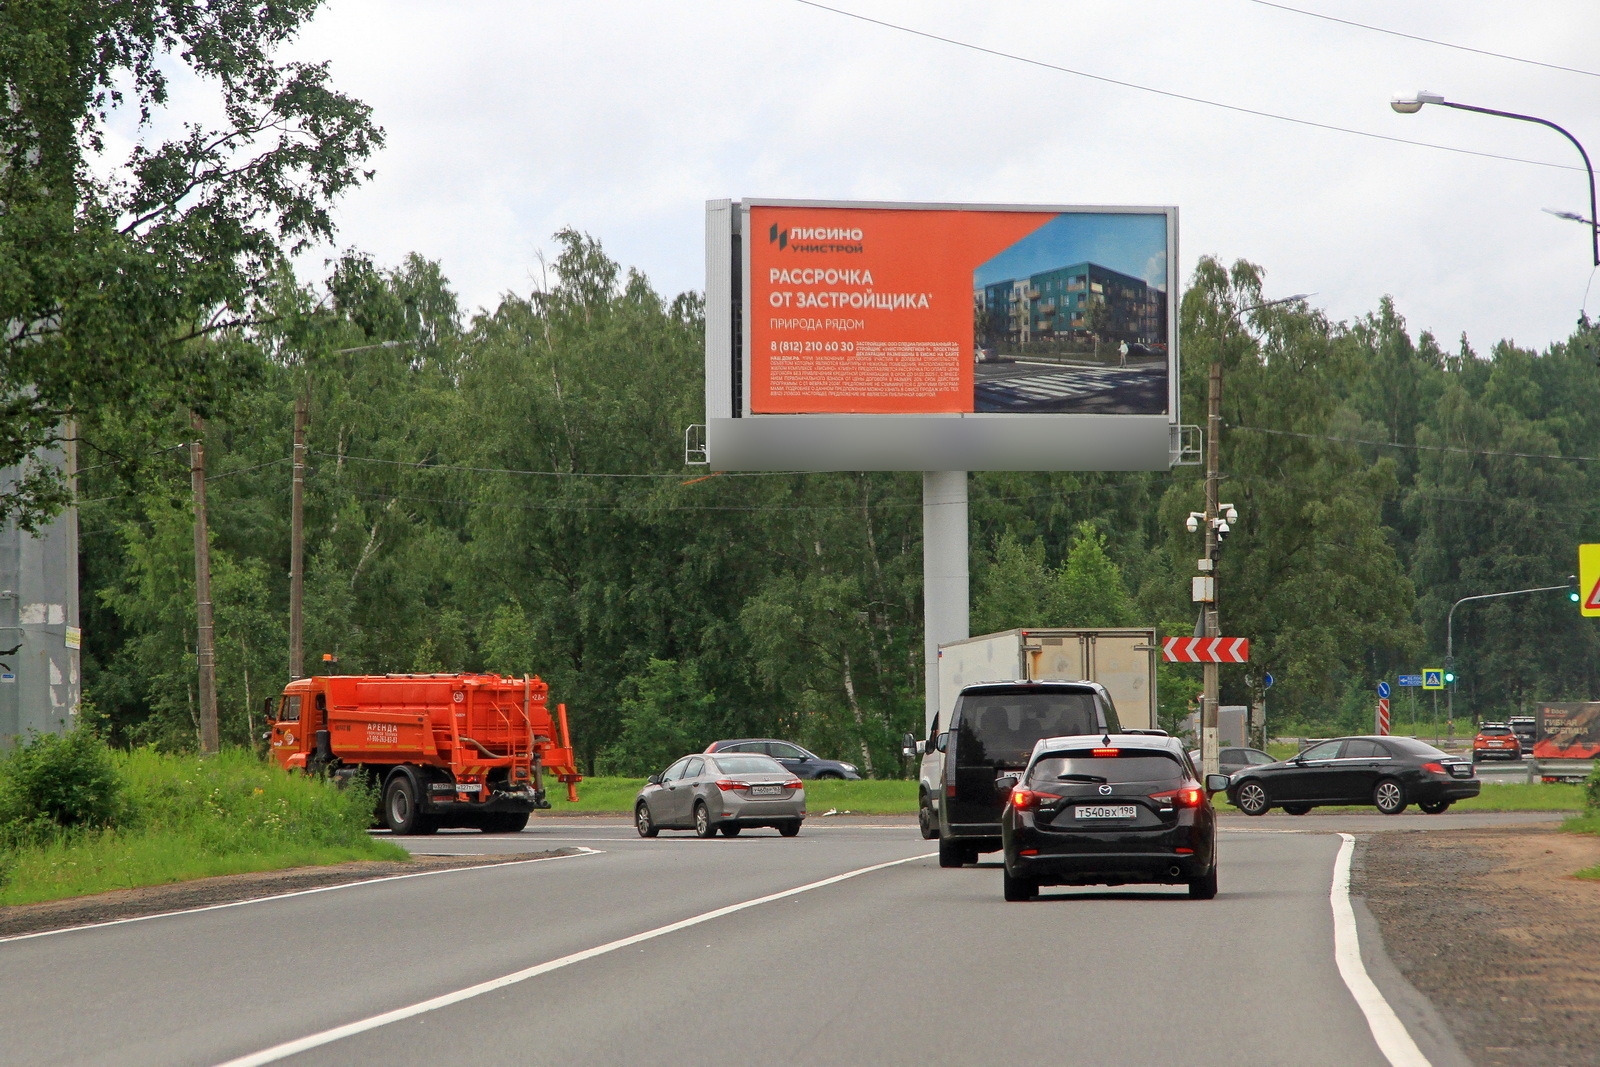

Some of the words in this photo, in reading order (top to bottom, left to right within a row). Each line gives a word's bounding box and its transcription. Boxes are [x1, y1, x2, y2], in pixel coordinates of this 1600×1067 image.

[790, 227, 862, 240] ЛИСИНО
[792, 243, 863, 254] УНИСТРОЙ
[770, 268, 874, 285] РАССРОЧКА
[770, 292, 792, 308] ОТ
[770, 318, 822, 330] ПРИРОДА
[826, 318, 864, 330] РЯДОМ
[770, 341, 777, 351] 8
[780, 341, 802, 353] (812)
[805, 341, 822, 351] 210
[825, 341, 838, 351] 60
[840, 341, 854, 352] 30
[367, 723, 398, 732] АРЕНДА
[1544, 727, 1589, 735] ЧЕРЕПИЦА
[1078, 807, 1117, 817] Т540ВХ
[1119, 806, 1134, 814] 198
